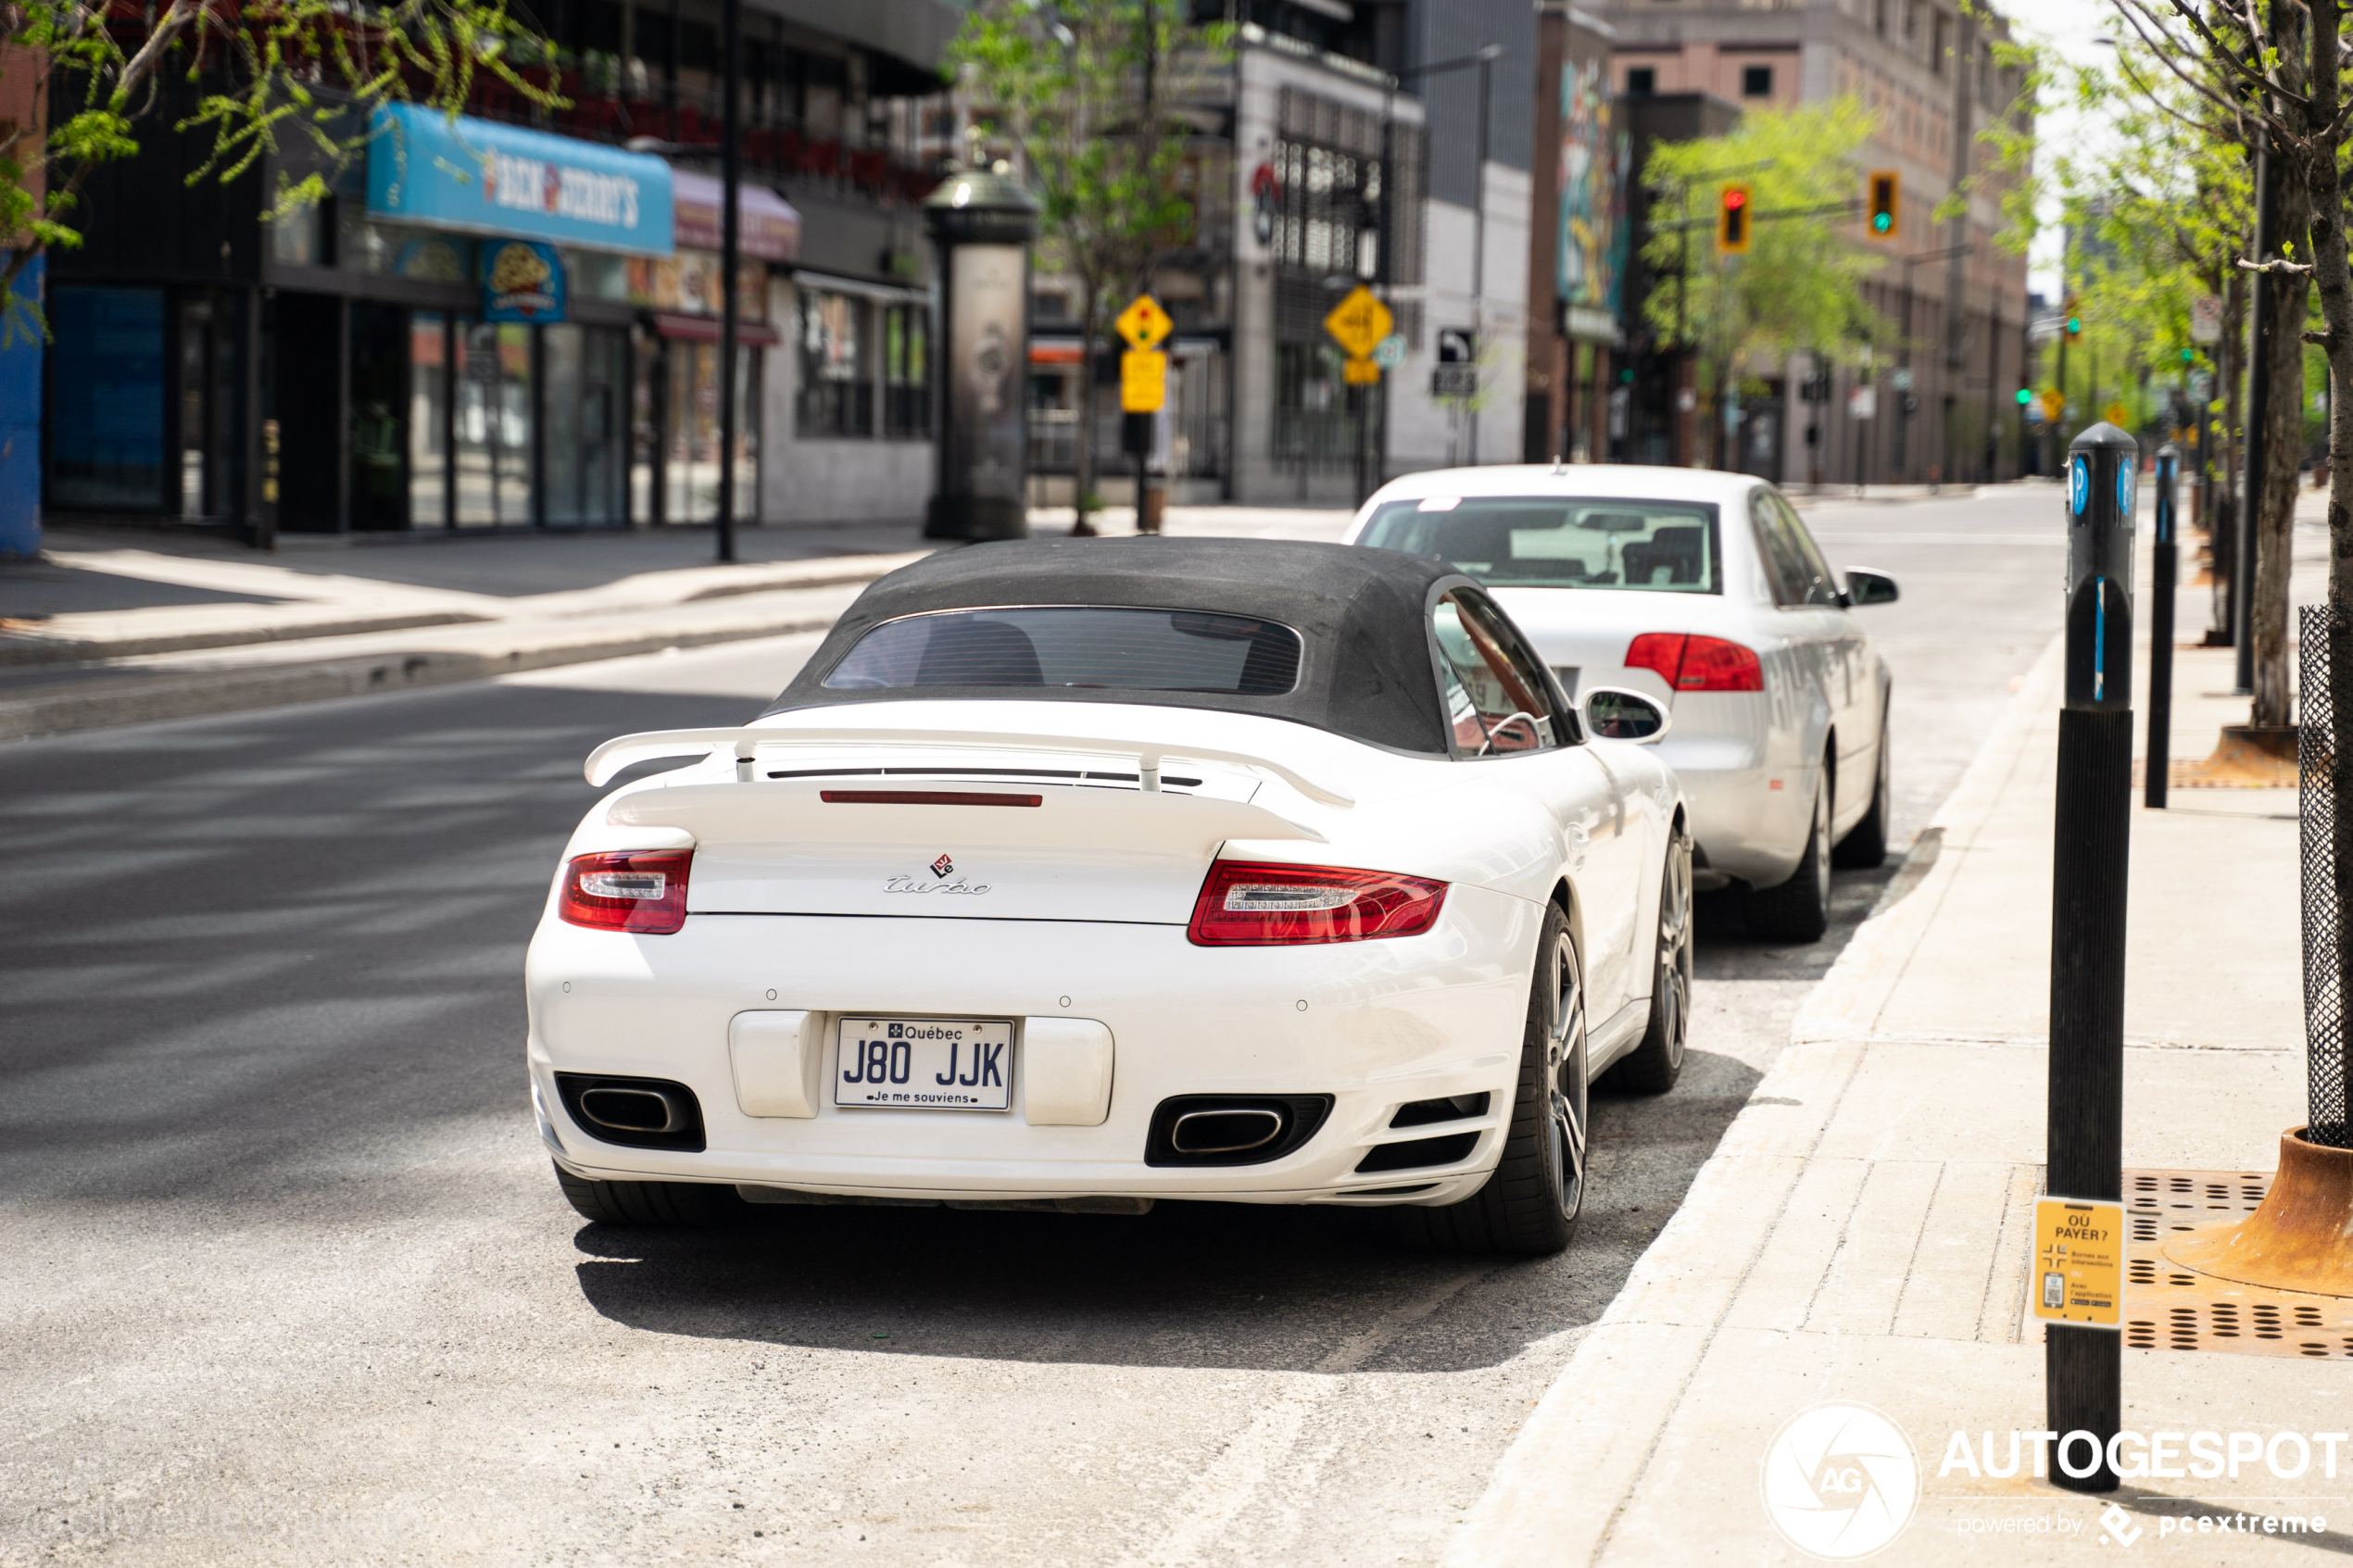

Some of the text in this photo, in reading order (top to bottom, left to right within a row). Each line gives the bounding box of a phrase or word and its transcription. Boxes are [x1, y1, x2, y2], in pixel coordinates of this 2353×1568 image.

[905, 1026, 963, 1039] Québec
[843, 1040, 1004, 1086] J80 JJK
[875, 1091, 969, 1103] Je me souviens
[2069, 1213, 2090, 1227] OÙ
[2071, 1251, 2095, 1260] Bornes
[2071, 1260, 2113, 1268] intersections
[2070, 1289, 2112, 1298] l'application
